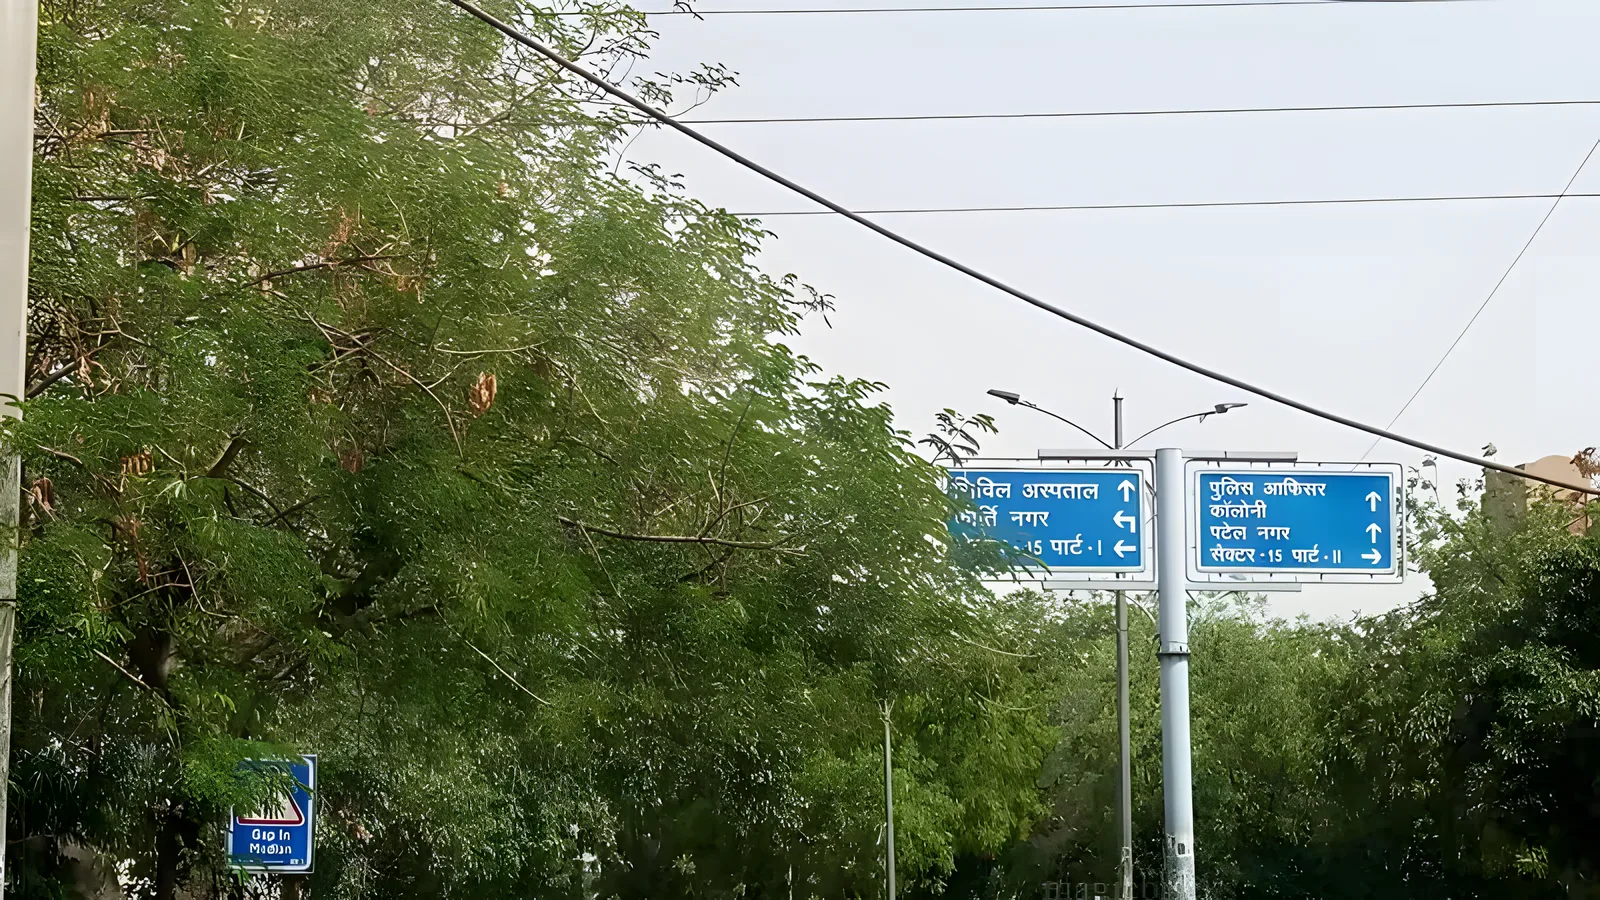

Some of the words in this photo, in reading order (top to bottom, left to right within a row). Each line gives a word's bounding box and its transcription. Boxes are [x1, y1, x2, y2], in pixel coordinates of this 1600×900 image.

[1022, 483, 1099, 500] अस्पताल
[1209, 476, 1254, 501] पुलिस
[1209, 499, 1267, 518] कॉलोनी
[1009, 511, 1050, 527] नगर
[1209, 521, 1247, 540] पटेल
[1256, 526, 1291, 540] नगर
[1049, 533, 1084, 556] पार्ट
[1291, 543, 1320, 563] पार्ट
